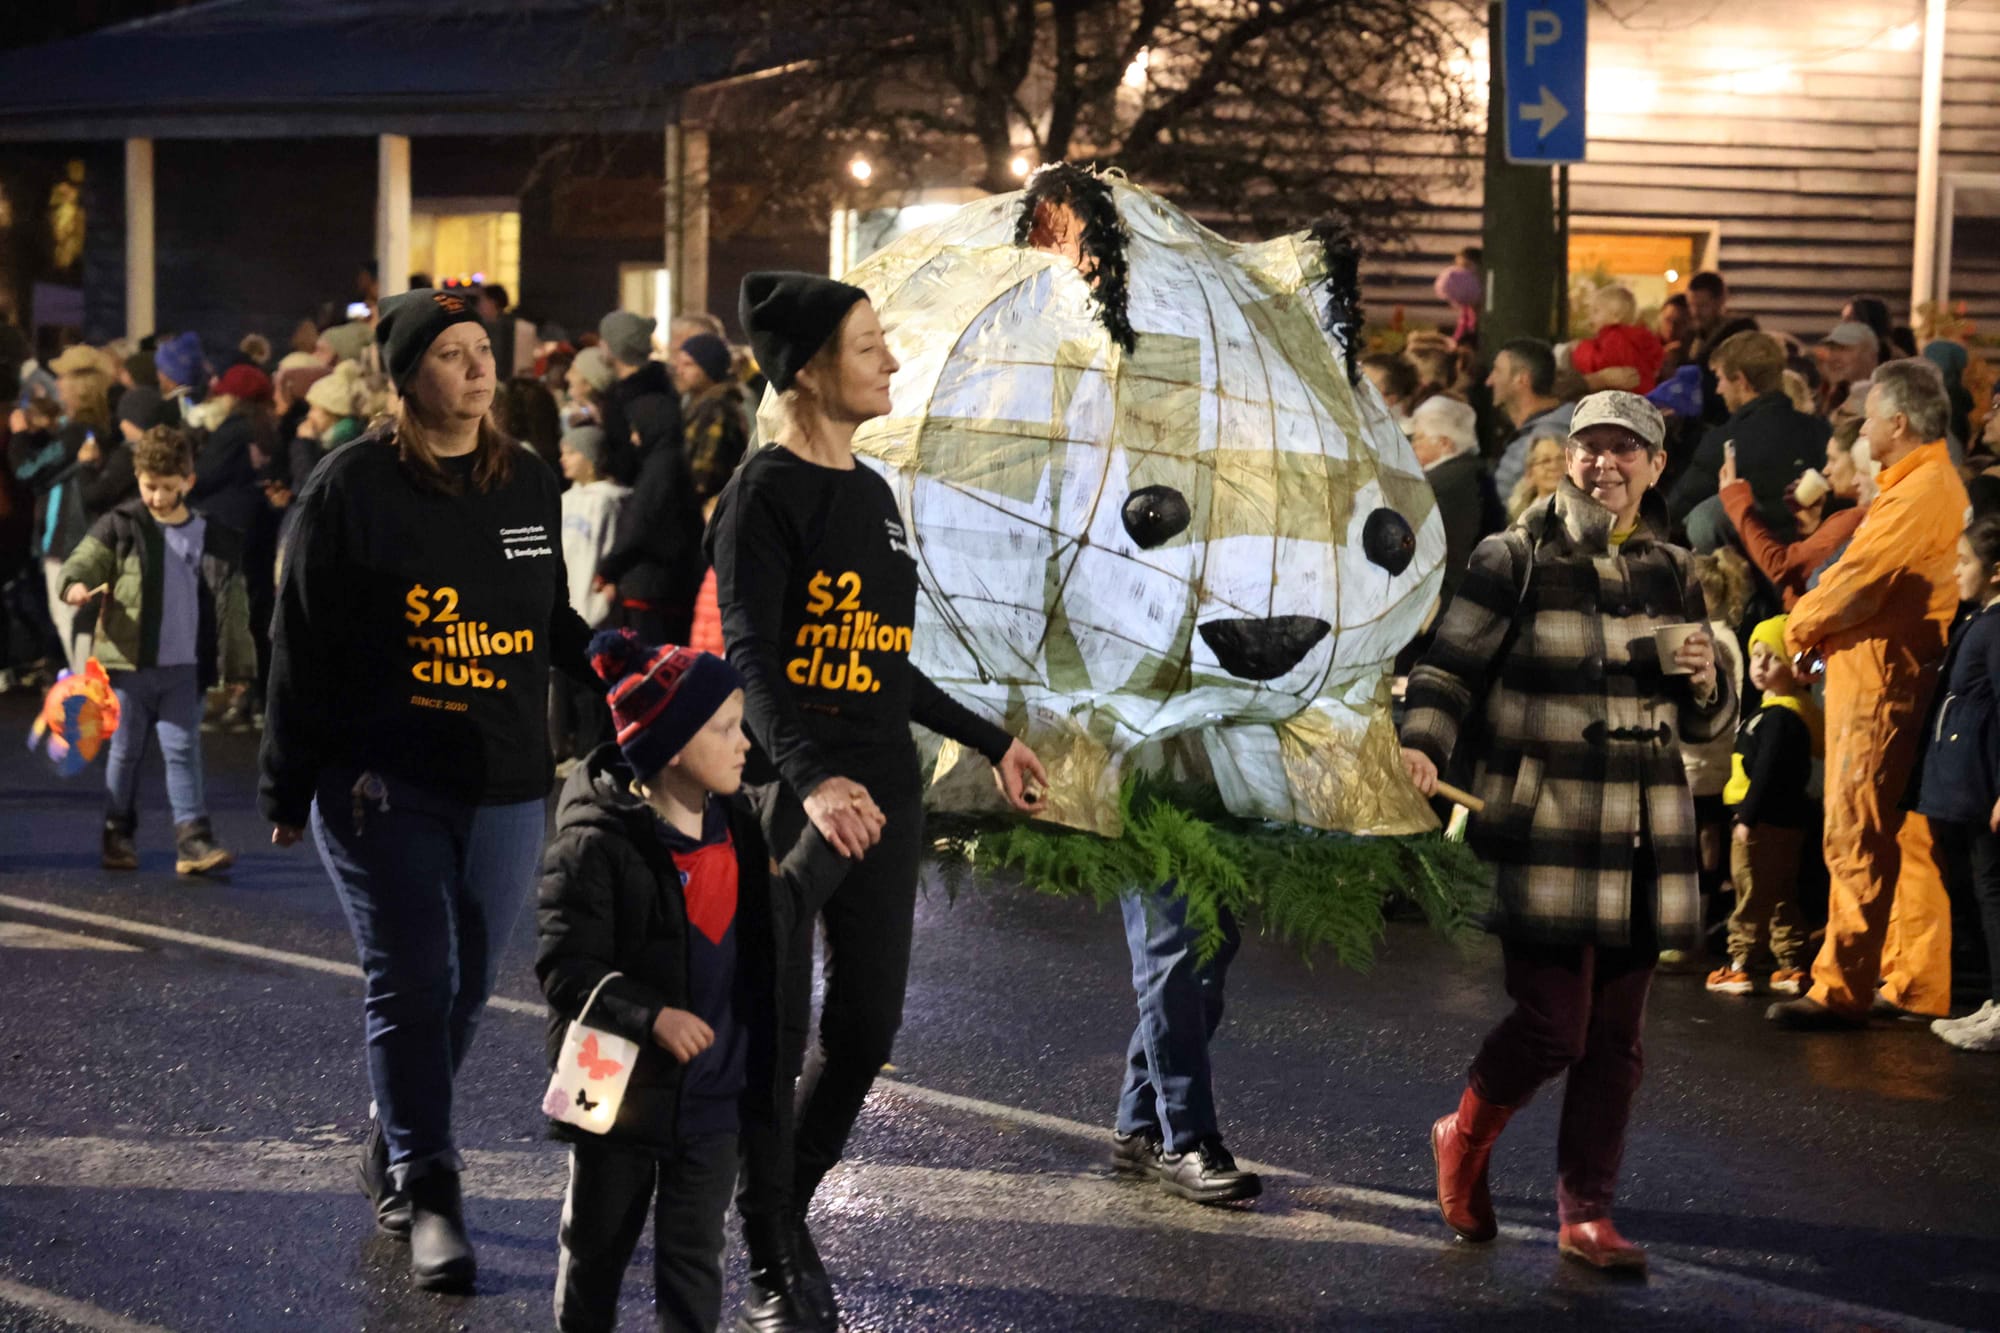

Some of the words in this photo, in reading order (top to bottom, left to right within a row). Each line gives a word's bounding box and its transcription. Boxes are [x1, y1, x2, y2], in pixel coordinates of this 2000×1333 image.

[1526, 10, 1562, 66] P
[405, 584, 460, 628] $2
[805, 570, 862, 617] $2
[407, 621, 534, 658] million
[796, 611, 913, 653] million
[411, 656, 507, 690] club.
[786, 647, 881, 693] club.
[410, 695, 444, 709] SINCE
